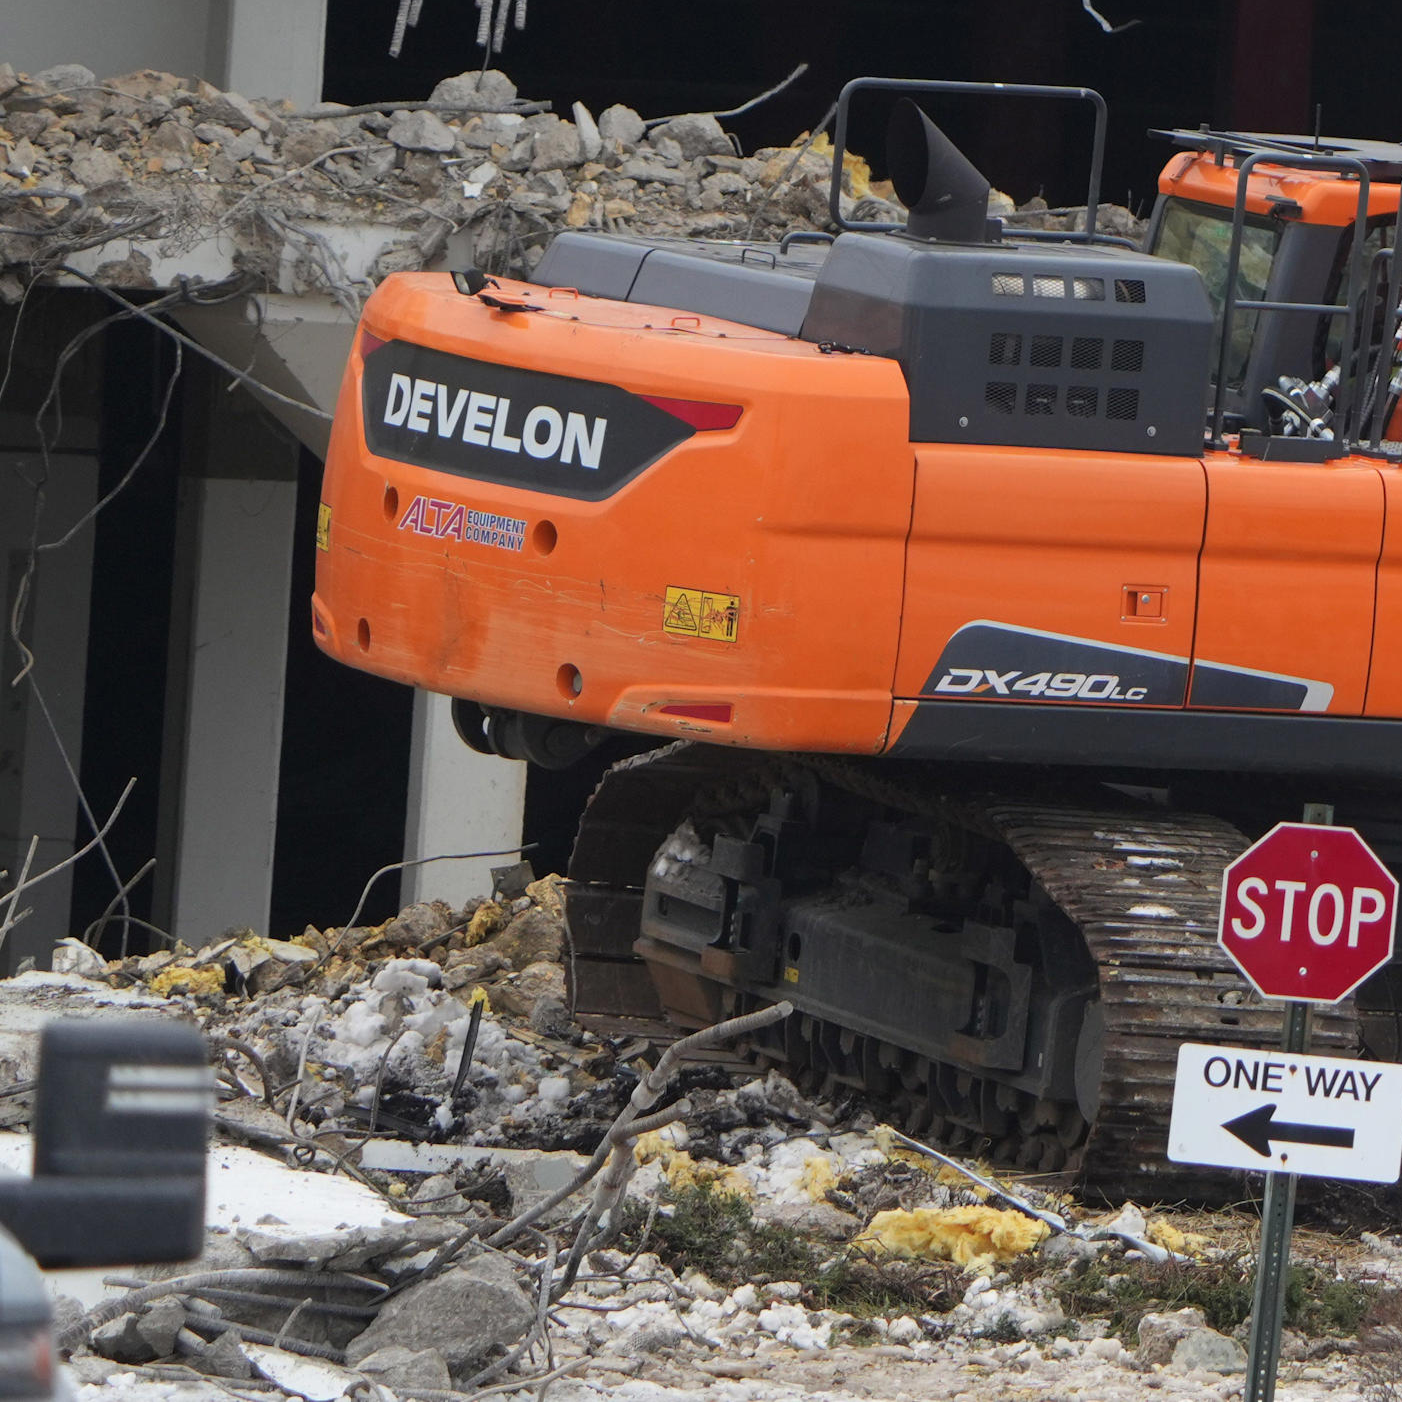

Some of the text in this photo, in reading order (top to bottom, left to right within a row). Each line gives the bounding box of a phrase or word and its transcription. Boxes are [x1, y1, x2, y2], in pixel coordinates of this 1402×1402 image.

[383, 373, 607, 469] DEVELON
[398, 495, 466, 542] ALTA
[465, 526, 524, 551] COMPANY
[467, 509, 527, 535] EQUIPMENT
[1231, 877, 1386, 948] STOP
[1204, 1056, 1382, 1102] ONE WAY
